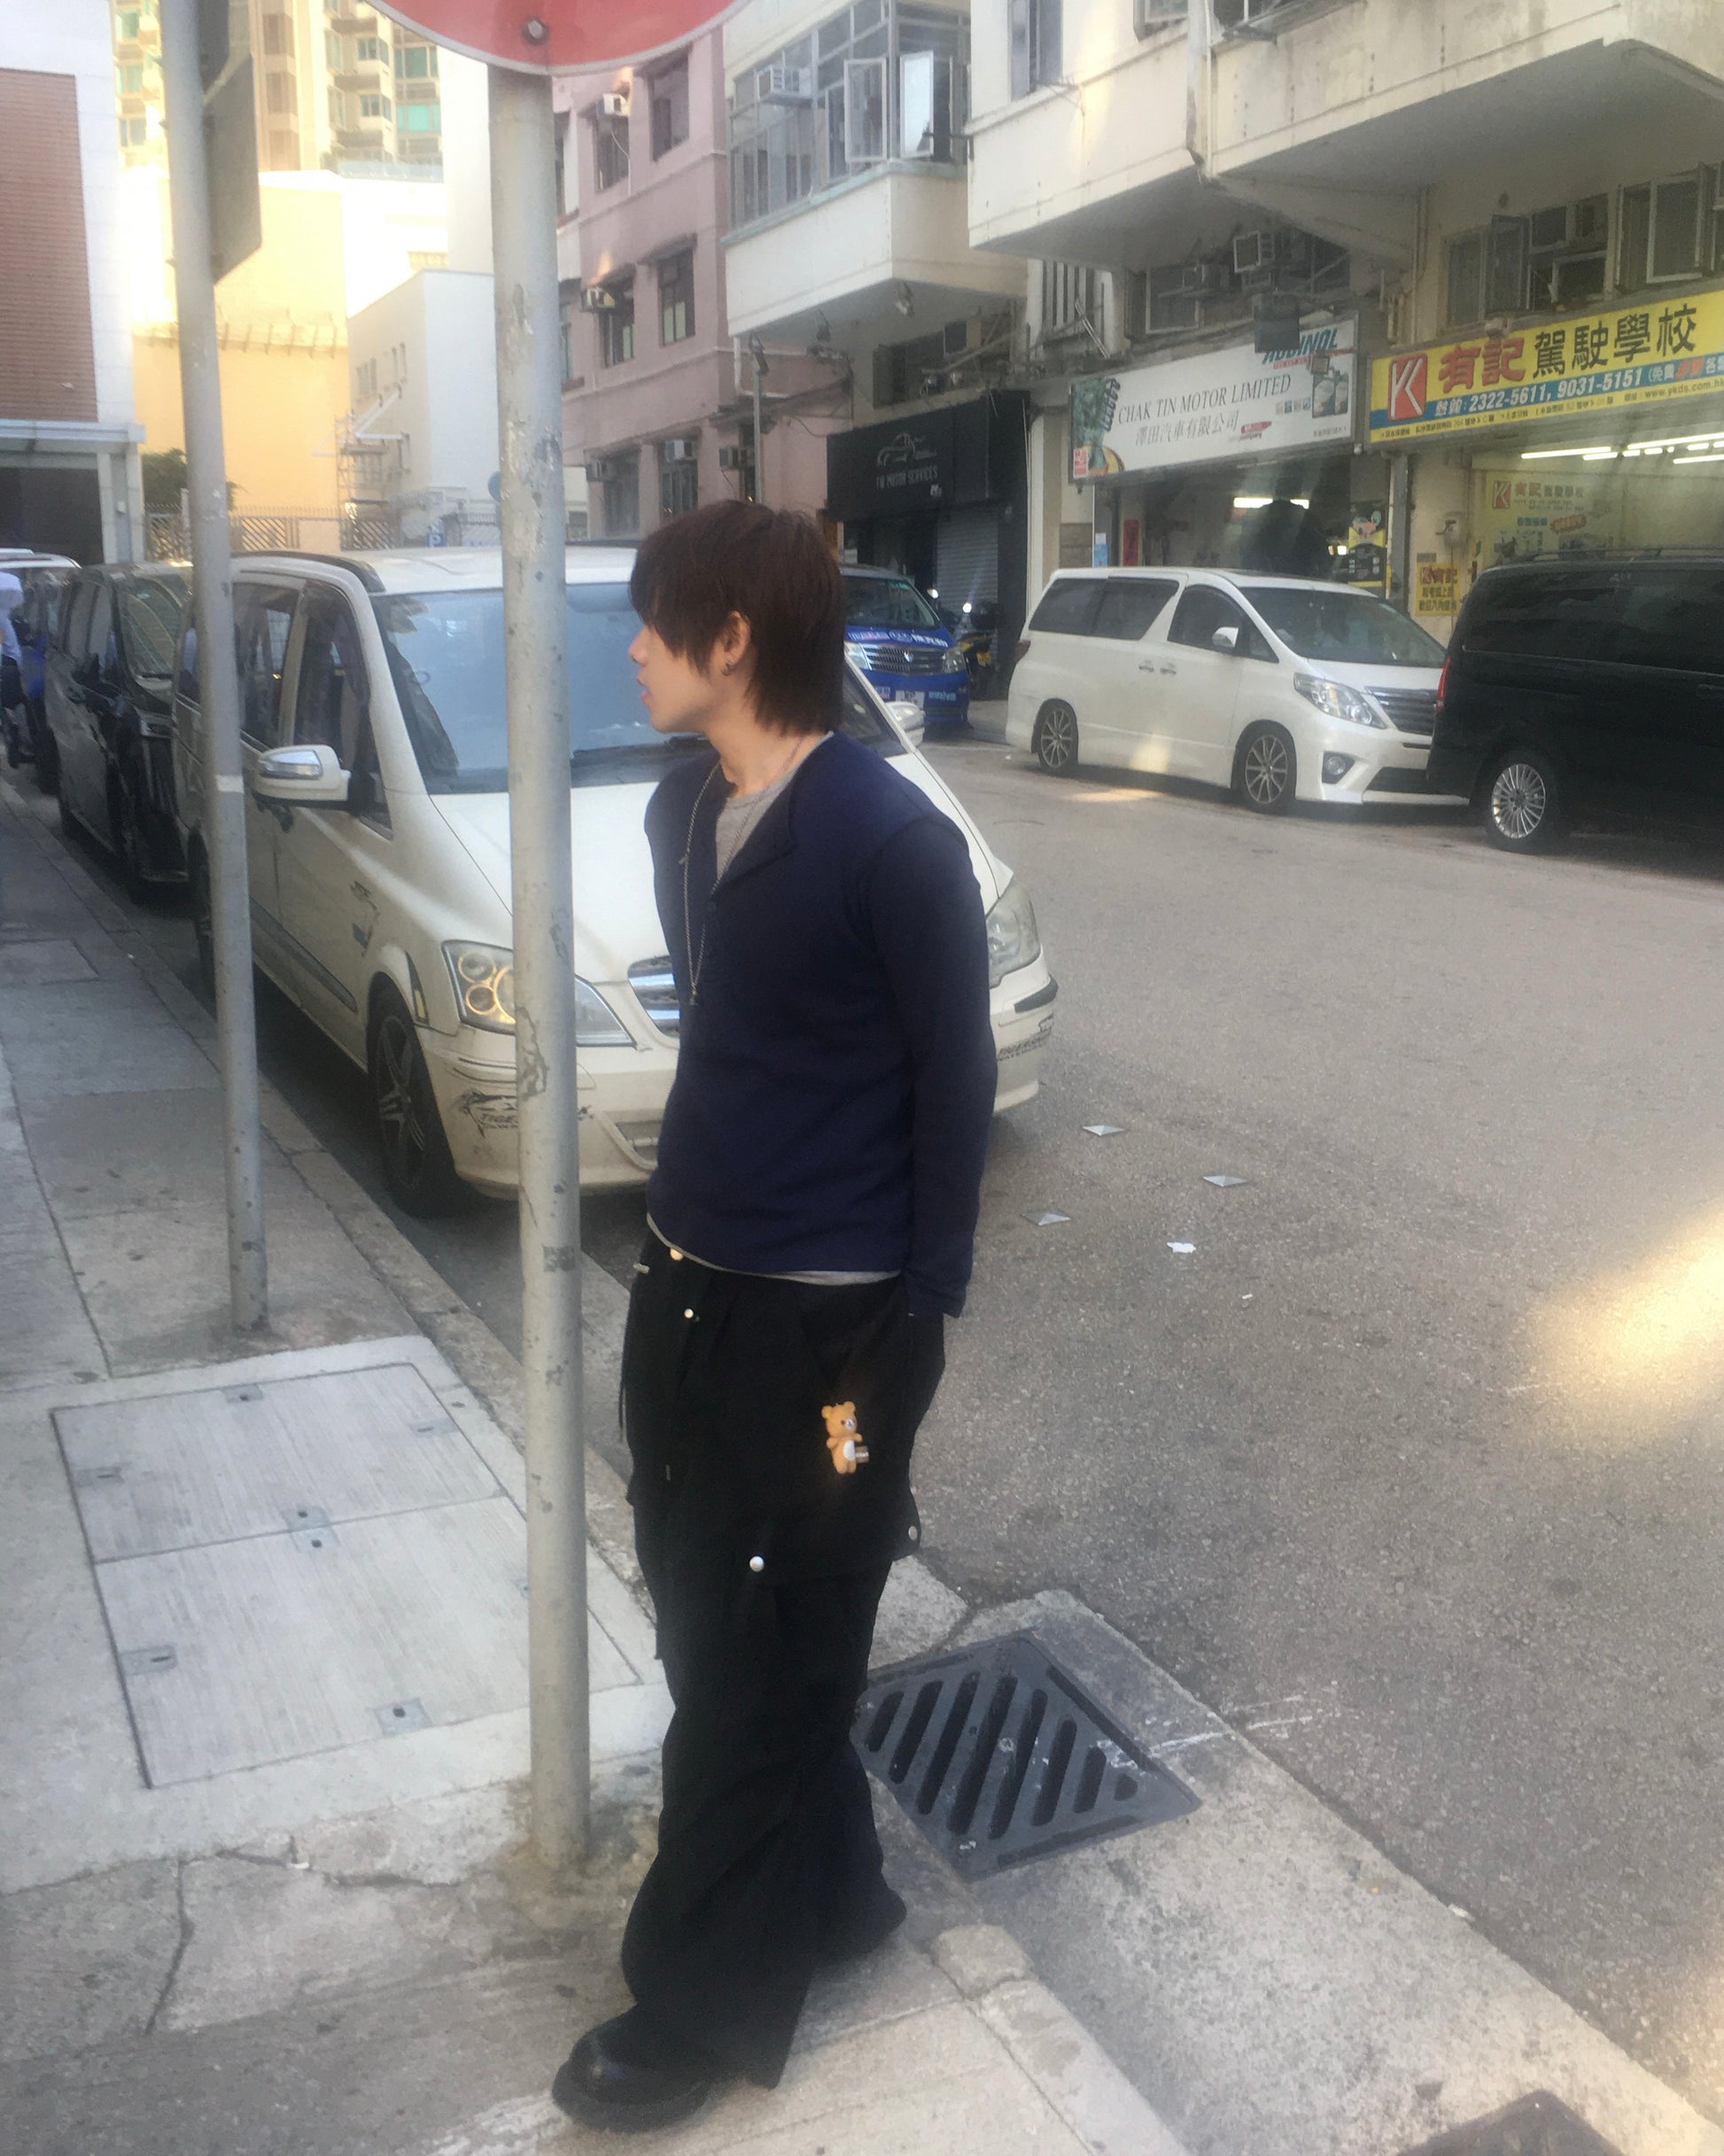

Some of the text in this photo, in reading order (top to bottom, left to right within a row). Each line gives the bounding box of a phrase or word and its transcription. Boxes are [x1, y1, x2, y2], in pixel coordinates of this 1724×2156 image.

[1439, 303, 1697, 394] 有記駕駛學校
[1119, 374, 1291, 424] CHAK TIN MOTOR LIMITED
[1468, 383, 1551, 413] 2322-5611,
[1557, 367, 1642, 399] 9031-5151
